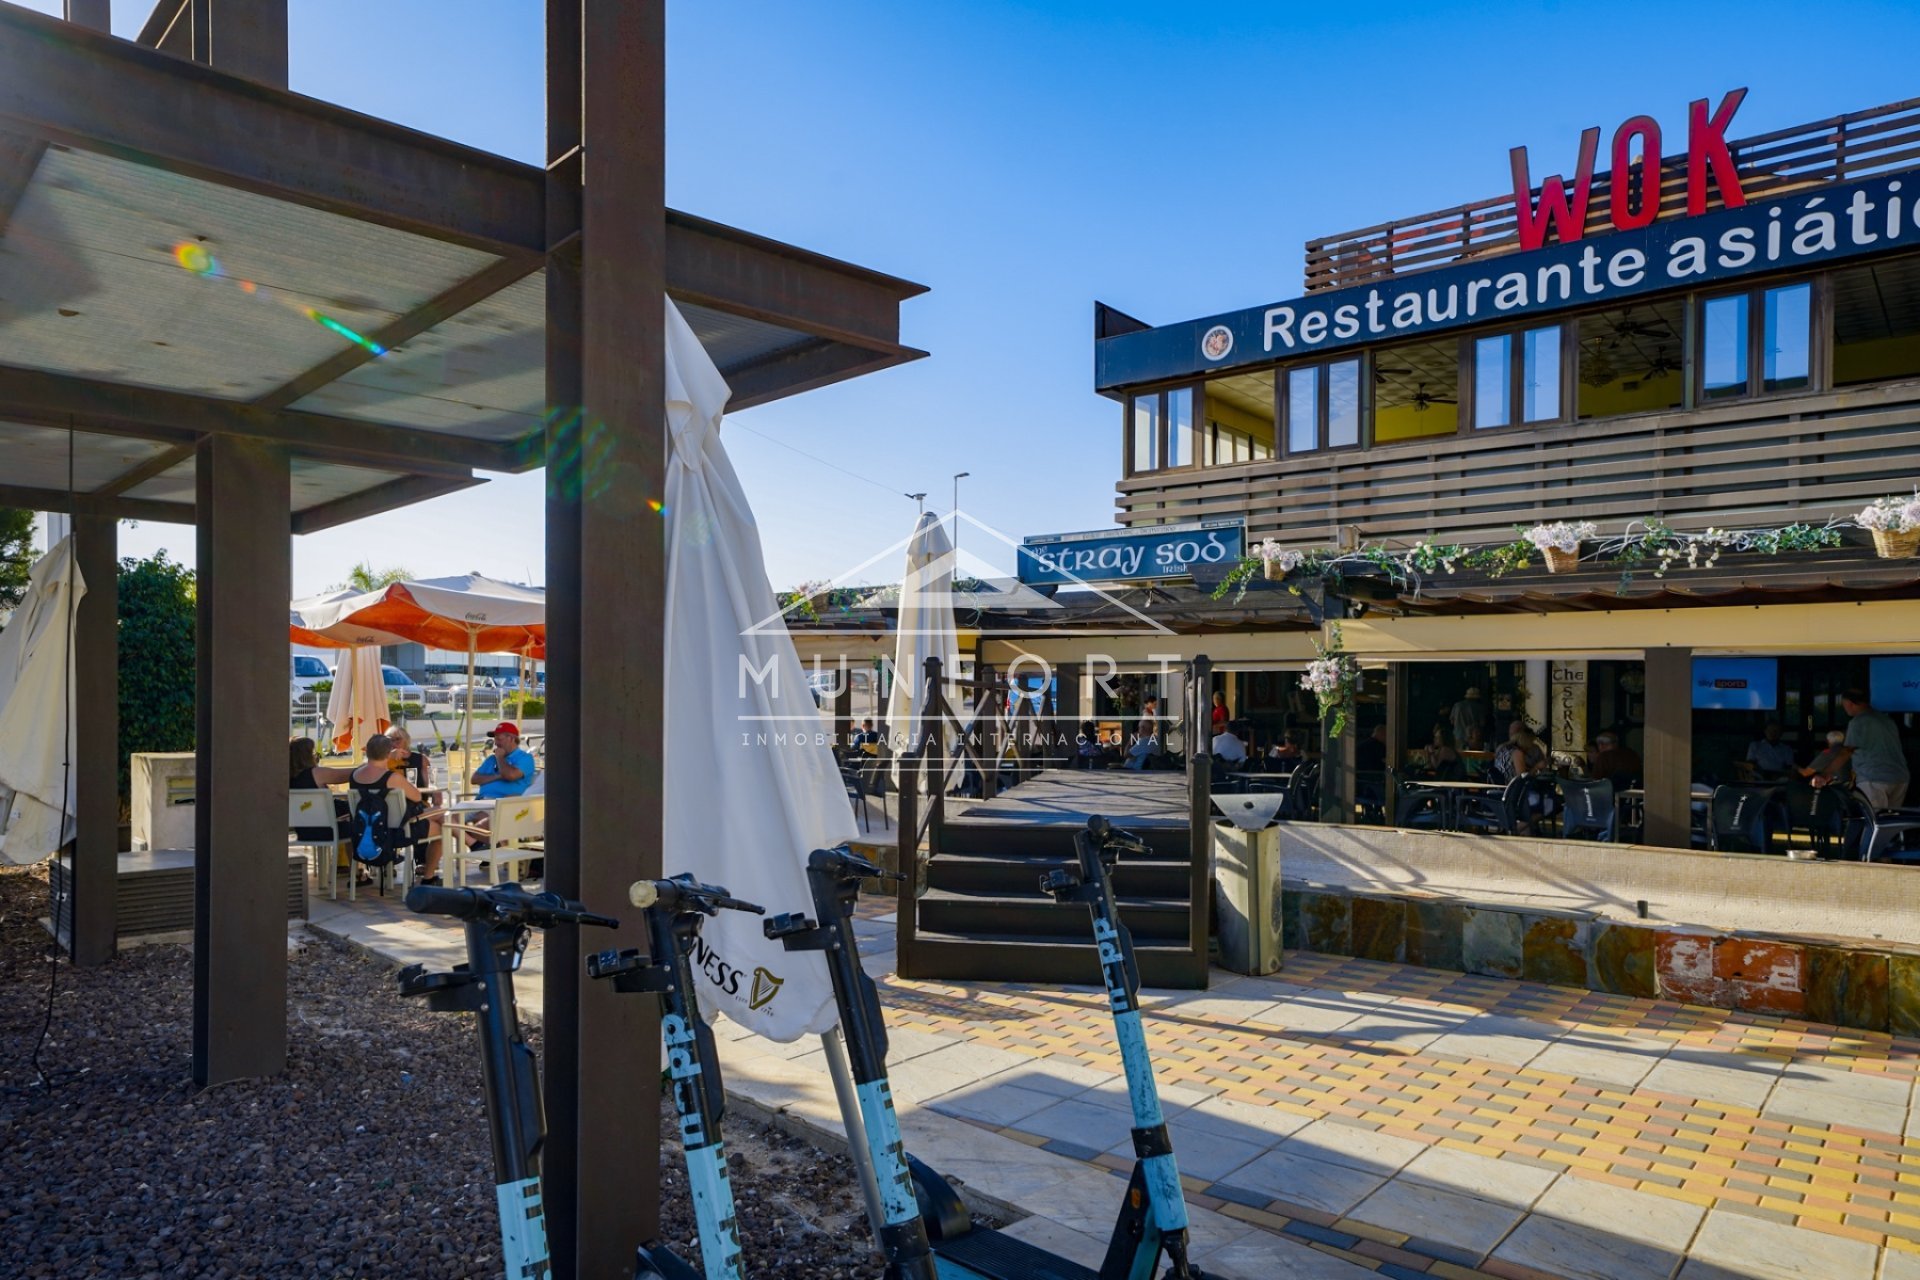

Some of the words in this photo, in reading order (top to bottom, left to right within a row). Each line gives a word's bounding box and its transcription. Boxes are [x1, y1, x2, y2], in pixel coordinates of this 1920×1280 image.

[1509, 87, 1748, 252] WOK
[1263, 245, 1646, 352] Restaurante
[1666, 180, 1920, 278] asiáti
[1553, 668, 1584, 681] The
